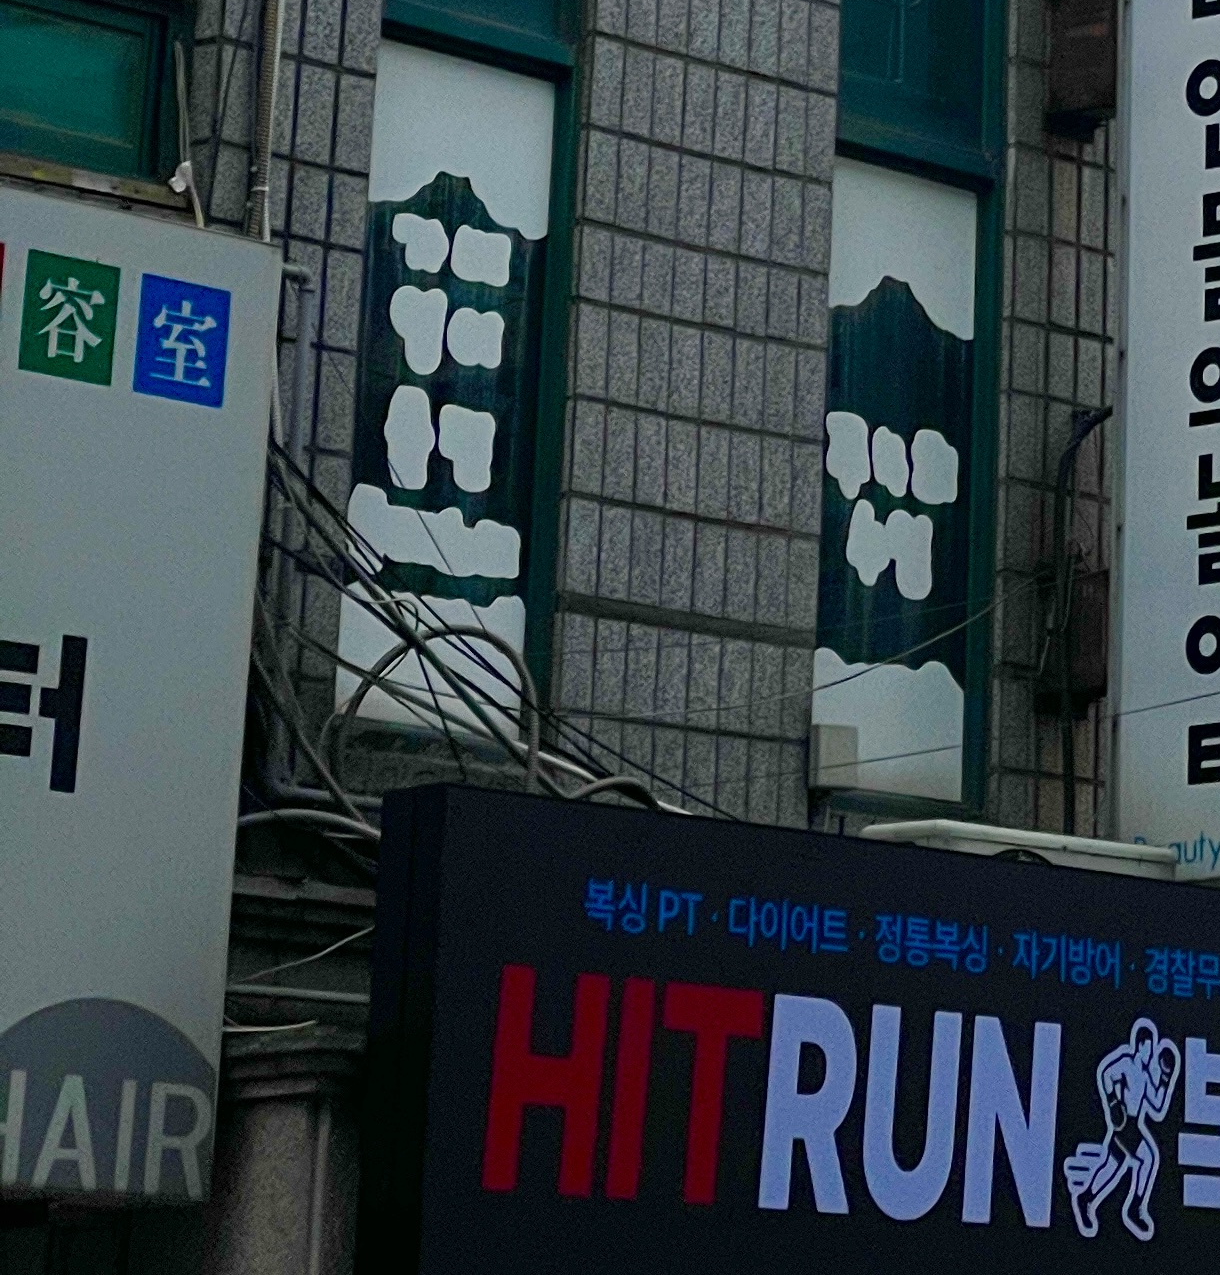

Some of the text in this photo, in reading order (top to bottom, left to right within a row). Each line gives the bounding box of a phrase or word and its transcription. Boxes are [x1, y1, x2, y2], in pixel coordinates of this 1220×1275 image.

[727, 895, 850, 954] 다이어트
[874, 913, 990, 974] 정통복싱
[1011, 929, 1122, 989] 자기방어
